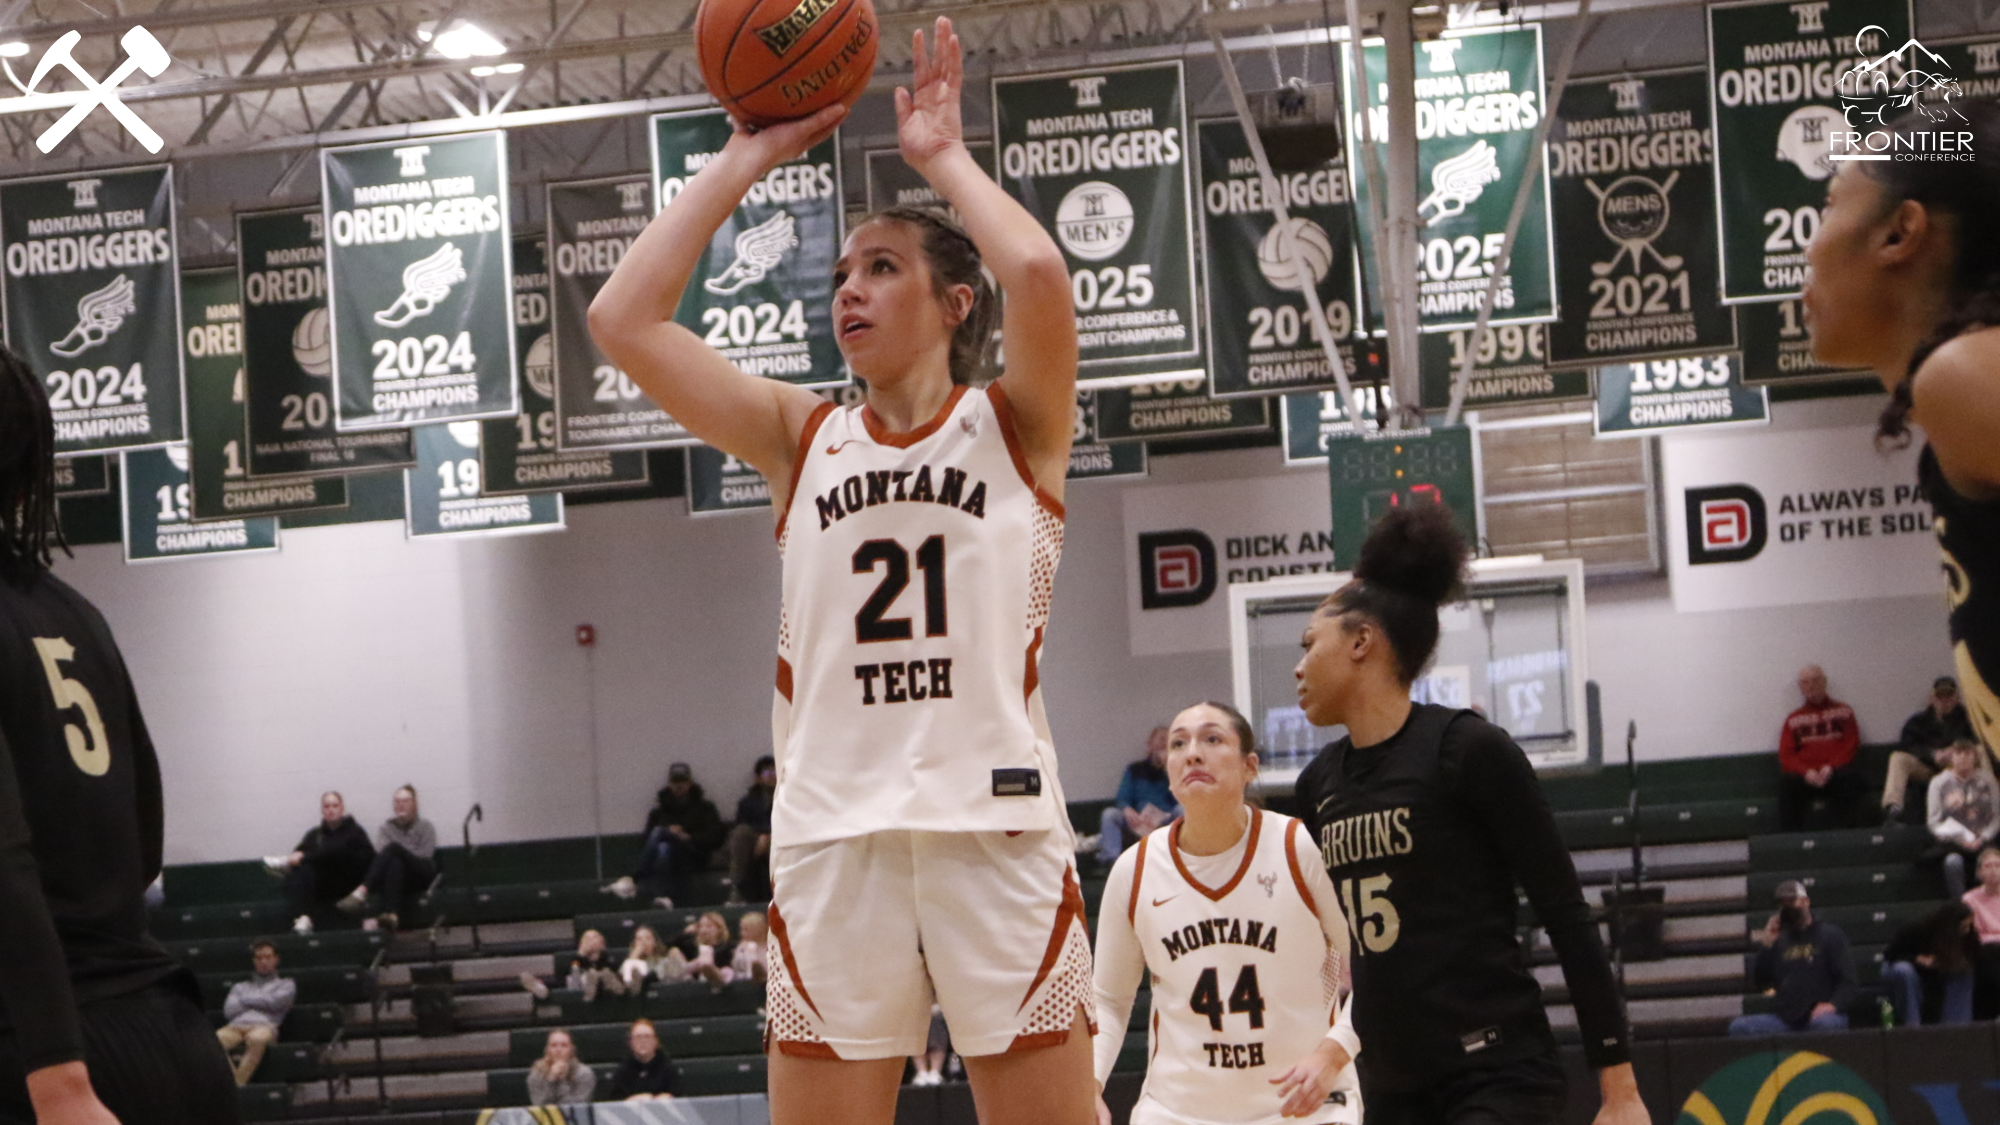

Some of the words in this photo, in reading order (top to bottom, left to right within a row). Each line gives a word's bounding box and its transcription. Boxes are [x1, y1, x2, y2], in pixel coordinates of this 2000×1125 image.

[781, 10, 872, 106] SPALDING
[1744, 39, 1831, 63] MONTANA
[1833, 33, 1879, 54] TECH
[1465, 71, 1510, 93] TECH
[1027, 113, 1108, 136] MONTANA
[1109, 108, 1153, 128] TECH
[1566, 115, 1647, 137] MONTANA
[1648, 110, 1692, 130] TECH
[1004, 127, 1180, 179] OREDIGGERS
[354, 181, 432, 204] MONTANA
[433, 176, 475, 197] TECH
[28, 213, 104, 235] MONTANA
[104, 208, 145, 228] TECH
[332, 195, 500, 246] OREDIGGERS
[1066, 221, 1126, 243] MEN'S
[6, 228, 171, 277] OREDIGGERS
[1072, 264, 1154, 311] 025
[1589, 270, 1691, 318] 2021
[702, 300, 808, 347] 2024
[1084, 310, 1167, 330] CONFERENCE
[1248, 300, 1351, 348] 2019
[1587, 317, 1632, 331] FRONTIER
[1107, 324, 1186, 345] CHAMPIONS
[1586, 324, 1697, 351] CHAMPIONS
[372, 330, 476, 380] 2024
[1248, 356, 1357, 385] CHAMPIOS
[1629, 356, 1730, 393] 1983
[46, 362, 147, 409] 2024
[373, 384, 479, 413] CHAMPIONS
[91, 402, 147, 418] CONFERENCE
[568, 412, 626, 427] FRONTIER
[1130, 405, 1232, 430] CHAMPIONS
[1630, 399, 1733, 425] CHAMPIONS
[284, 438, 336, 452] NATIONAL
[336, 431, 409, 448] TOURNAMENT
[568, 424, 649, 440] TOURNAMENT
[1364, 427, 1431, 442] DAKTRONICS
[311, 451, 339, 463] FINAL
[515, 459, 613, 482] CHAMPIONS
[223, 484, 316, 509] CHAMPIONS
[815, 464, 988, 531] MONTANA
[1779, 486, 1885, 515] ALWAYS
[439, 504, 532, 529] CHAMPIONS
[1780, 521, 1813, 543] OF
[1821, 515, 1872, 541] THE
[156, 528, 248, 551] CHAMPIONS
[1226, 533, 1289, 560] DICK
[851, 534, 948, 644] 21
[854, 658, 953, 705] TECH
[33, 636, 111, 777] 5
[1321, 807, 1413, 870] BRUINS
[1161, 917, 1278, 962] MONTANA
[1189, 963, 1266, 1032] 44
[1203, 1042, 1266, 1069] TECH
